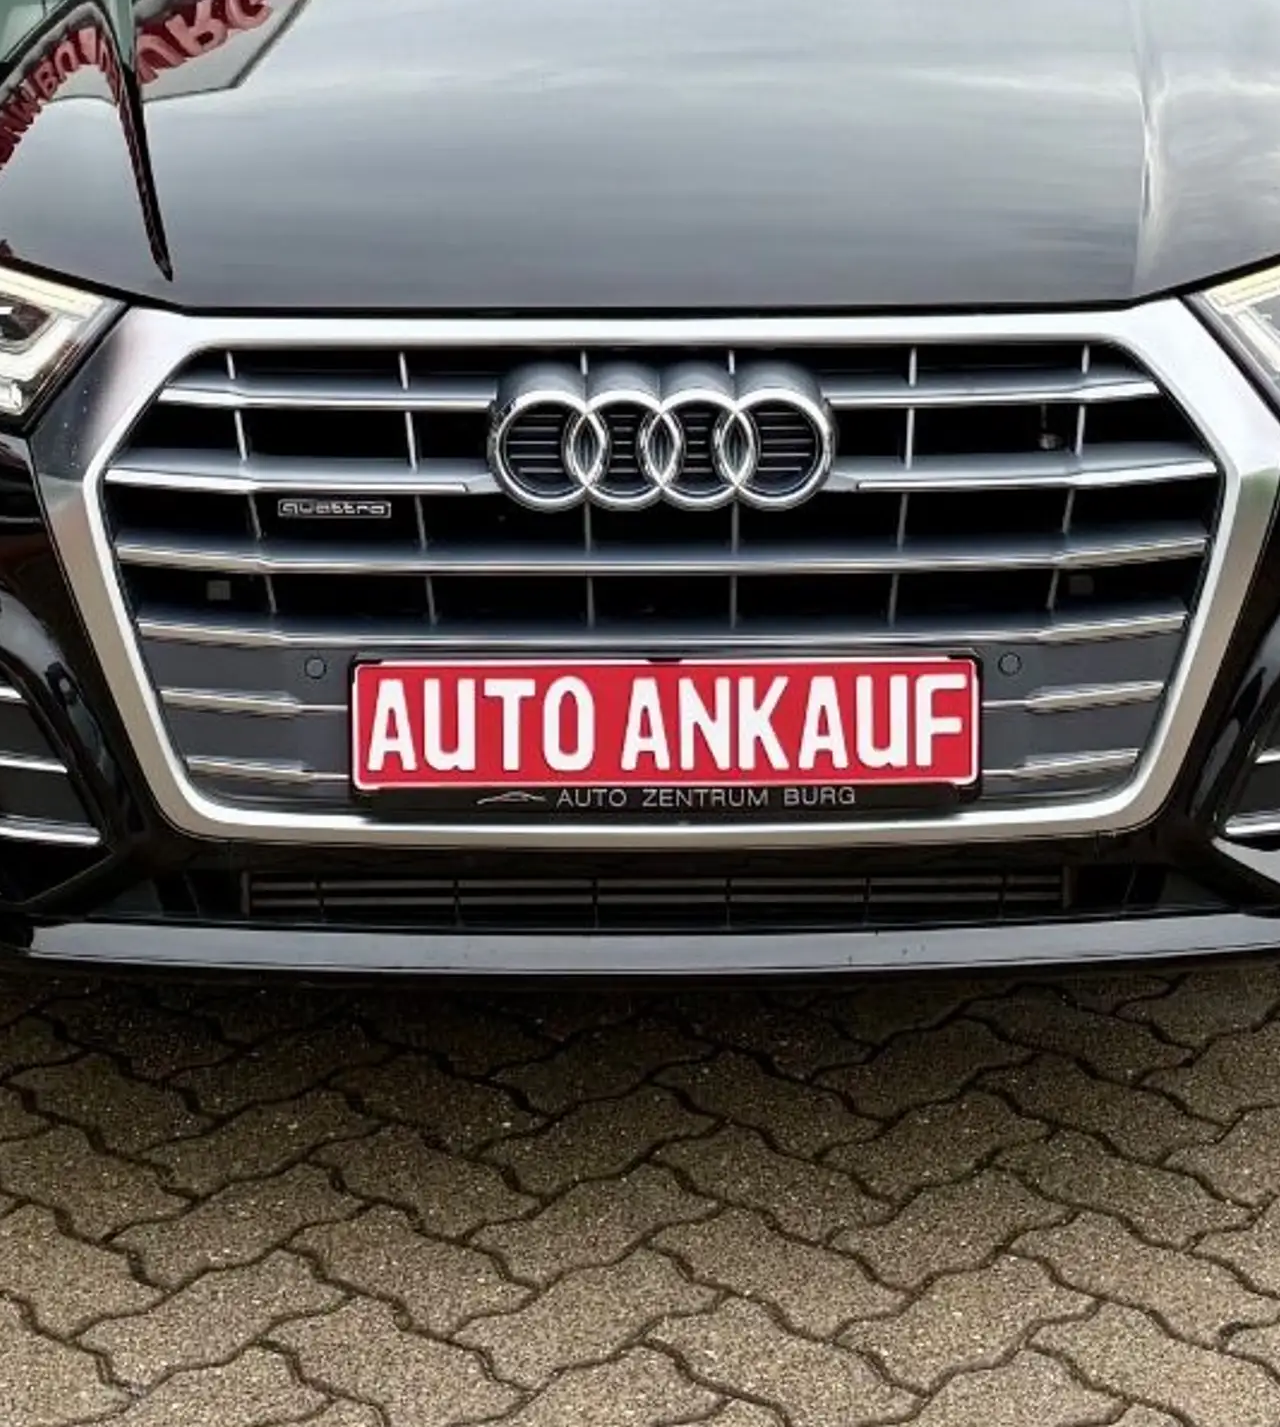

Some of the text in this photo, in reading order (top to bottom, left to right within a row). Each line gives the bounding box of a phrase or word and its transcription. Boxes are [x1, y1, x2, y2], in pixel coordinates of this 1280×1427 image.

[281, 501, 387, 517] quattro
[366, 672, 967, 773] AUTO ANKAUF
[555, 786, 857, 808] AUTO ZENTRUM BURG
